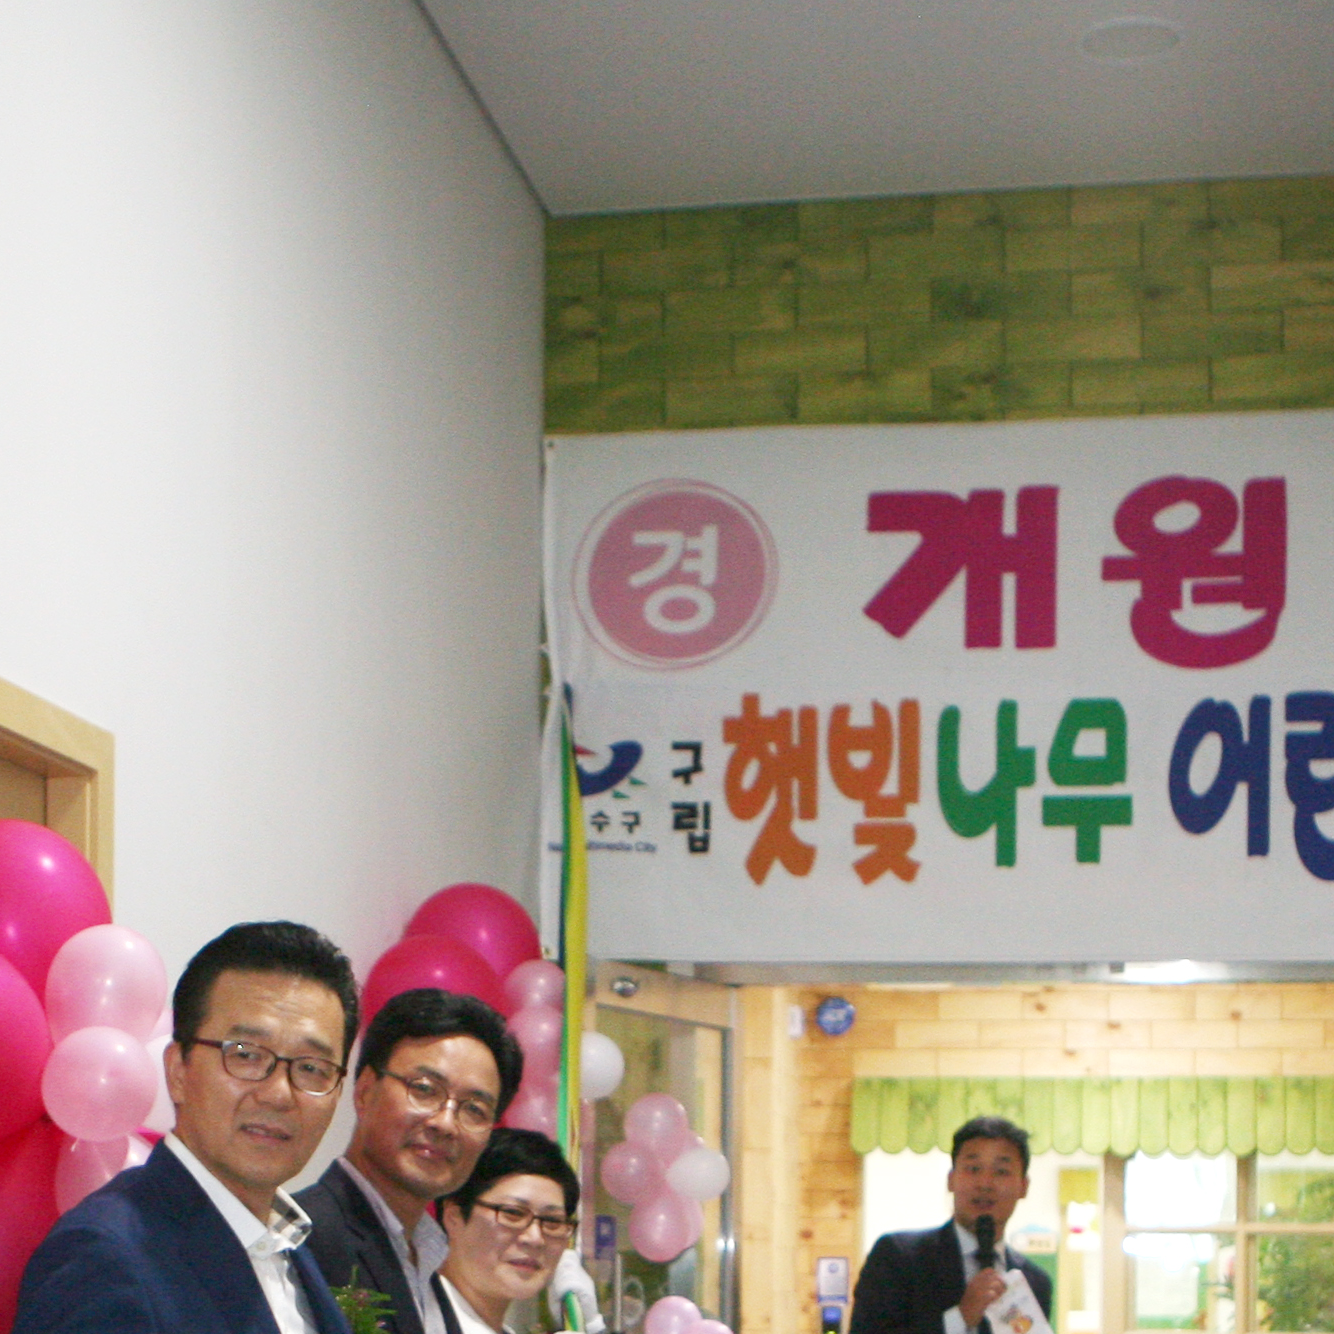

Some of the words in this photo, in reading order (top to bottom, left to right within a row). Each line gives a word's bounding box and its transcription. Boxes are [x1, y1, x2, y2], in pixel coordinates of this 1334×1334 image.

[630, 522, 719, 637] 경
[863, 475, 1288, 669] 개원
[590, 811, 641, 833] 수구
[722, 693, 1134, 885] 햇빛나무
